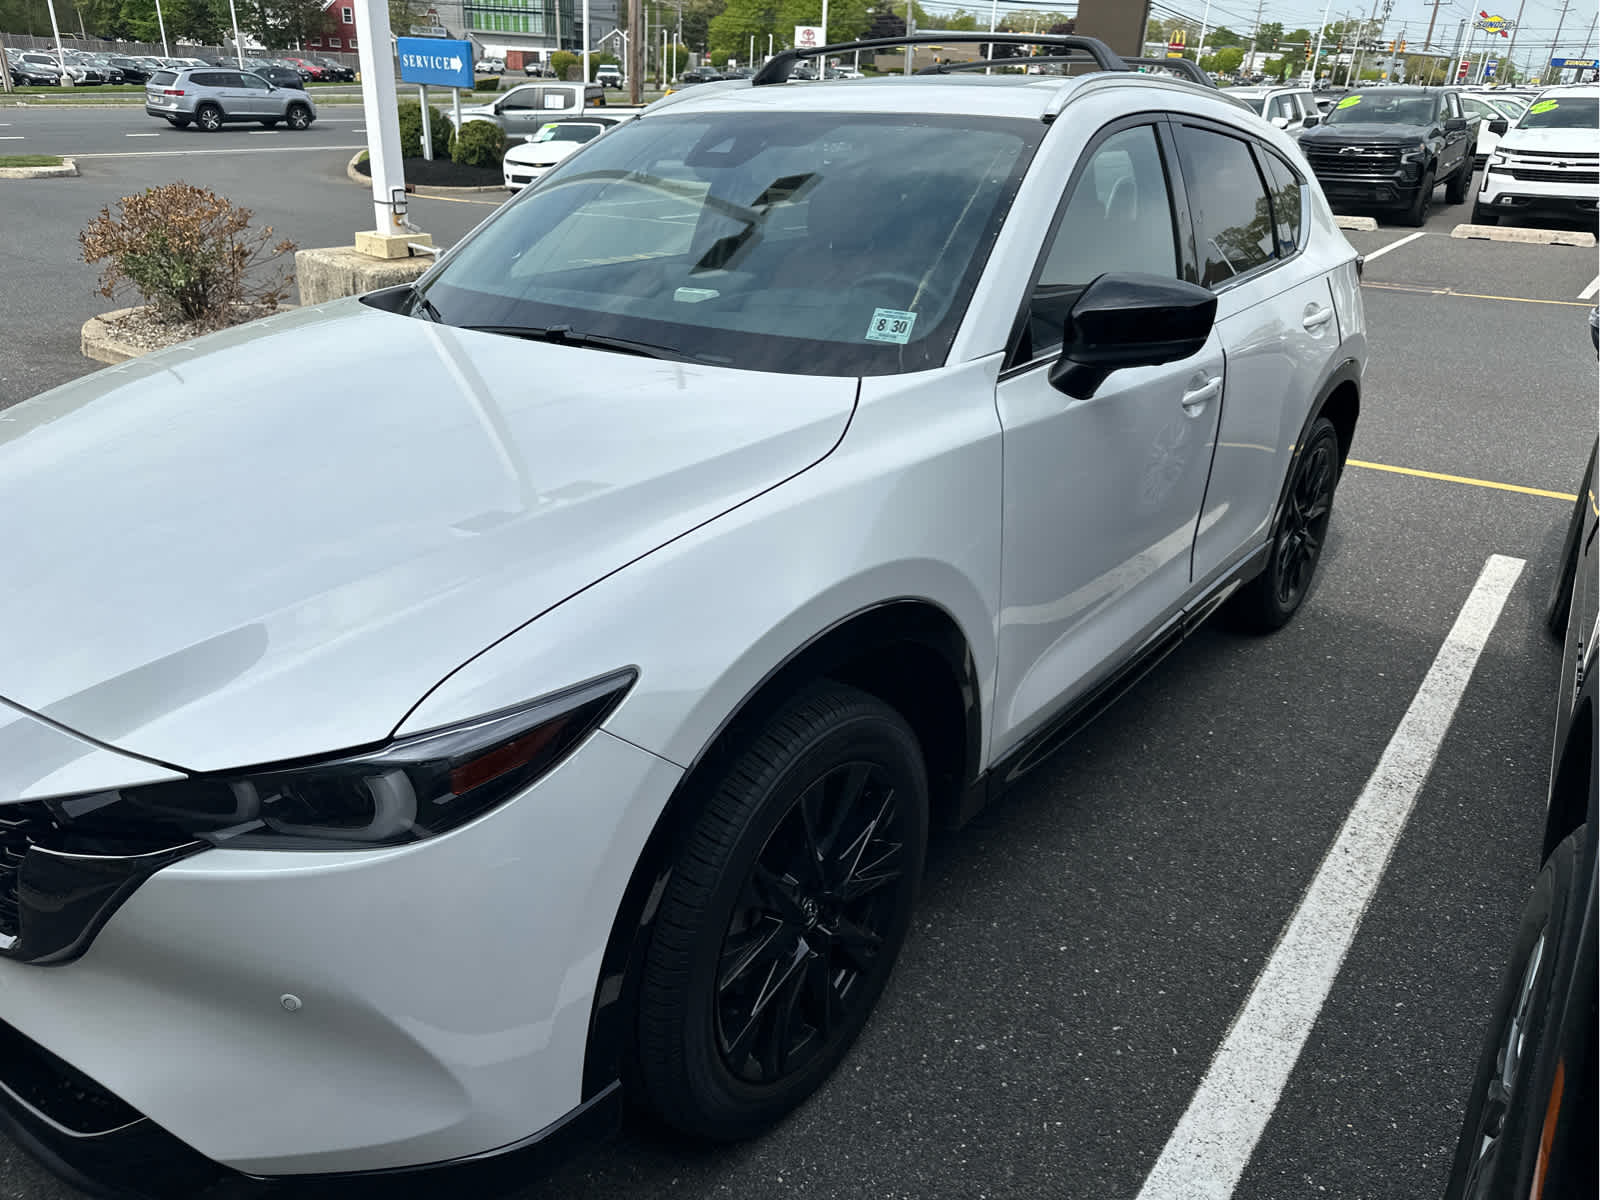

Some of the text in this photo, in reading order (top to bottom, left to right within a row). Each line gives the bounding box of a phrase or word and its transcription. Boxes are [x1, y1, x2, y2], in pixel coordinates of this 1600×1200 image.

[1476, 20, 1514, 31] SUNOCO
[402, 54, 450, 71] SERVICE
[877, 318, 908, 334] 8 30
